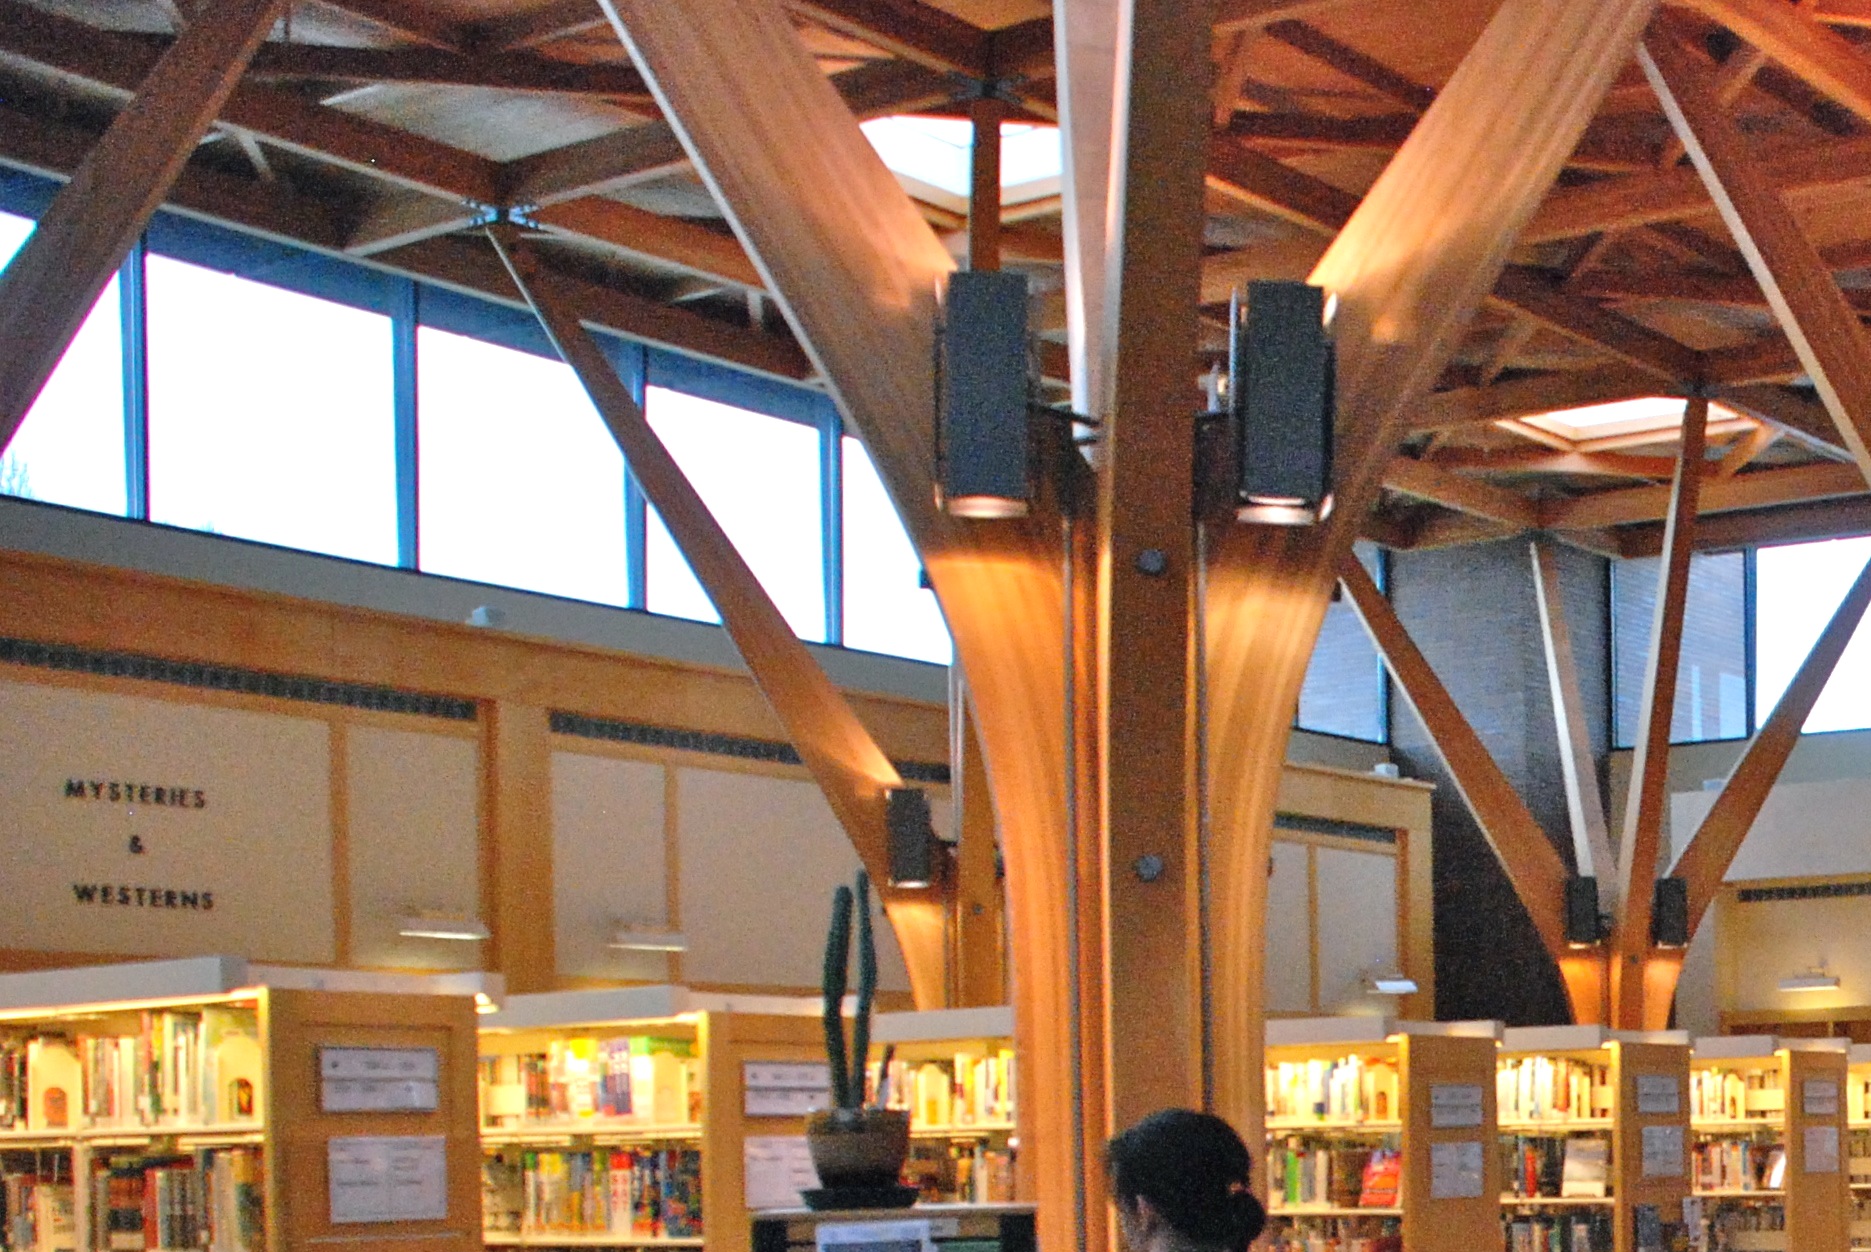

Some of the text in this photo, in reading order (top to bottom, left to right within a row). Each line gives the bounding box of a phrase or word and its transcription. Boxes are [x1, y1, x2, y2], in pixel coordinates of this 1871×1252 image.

[64, 778, 206, 808] MYSTERIES
[128, 834, 145, 855] &
[72, 883, 215, 911] WESTERNS
